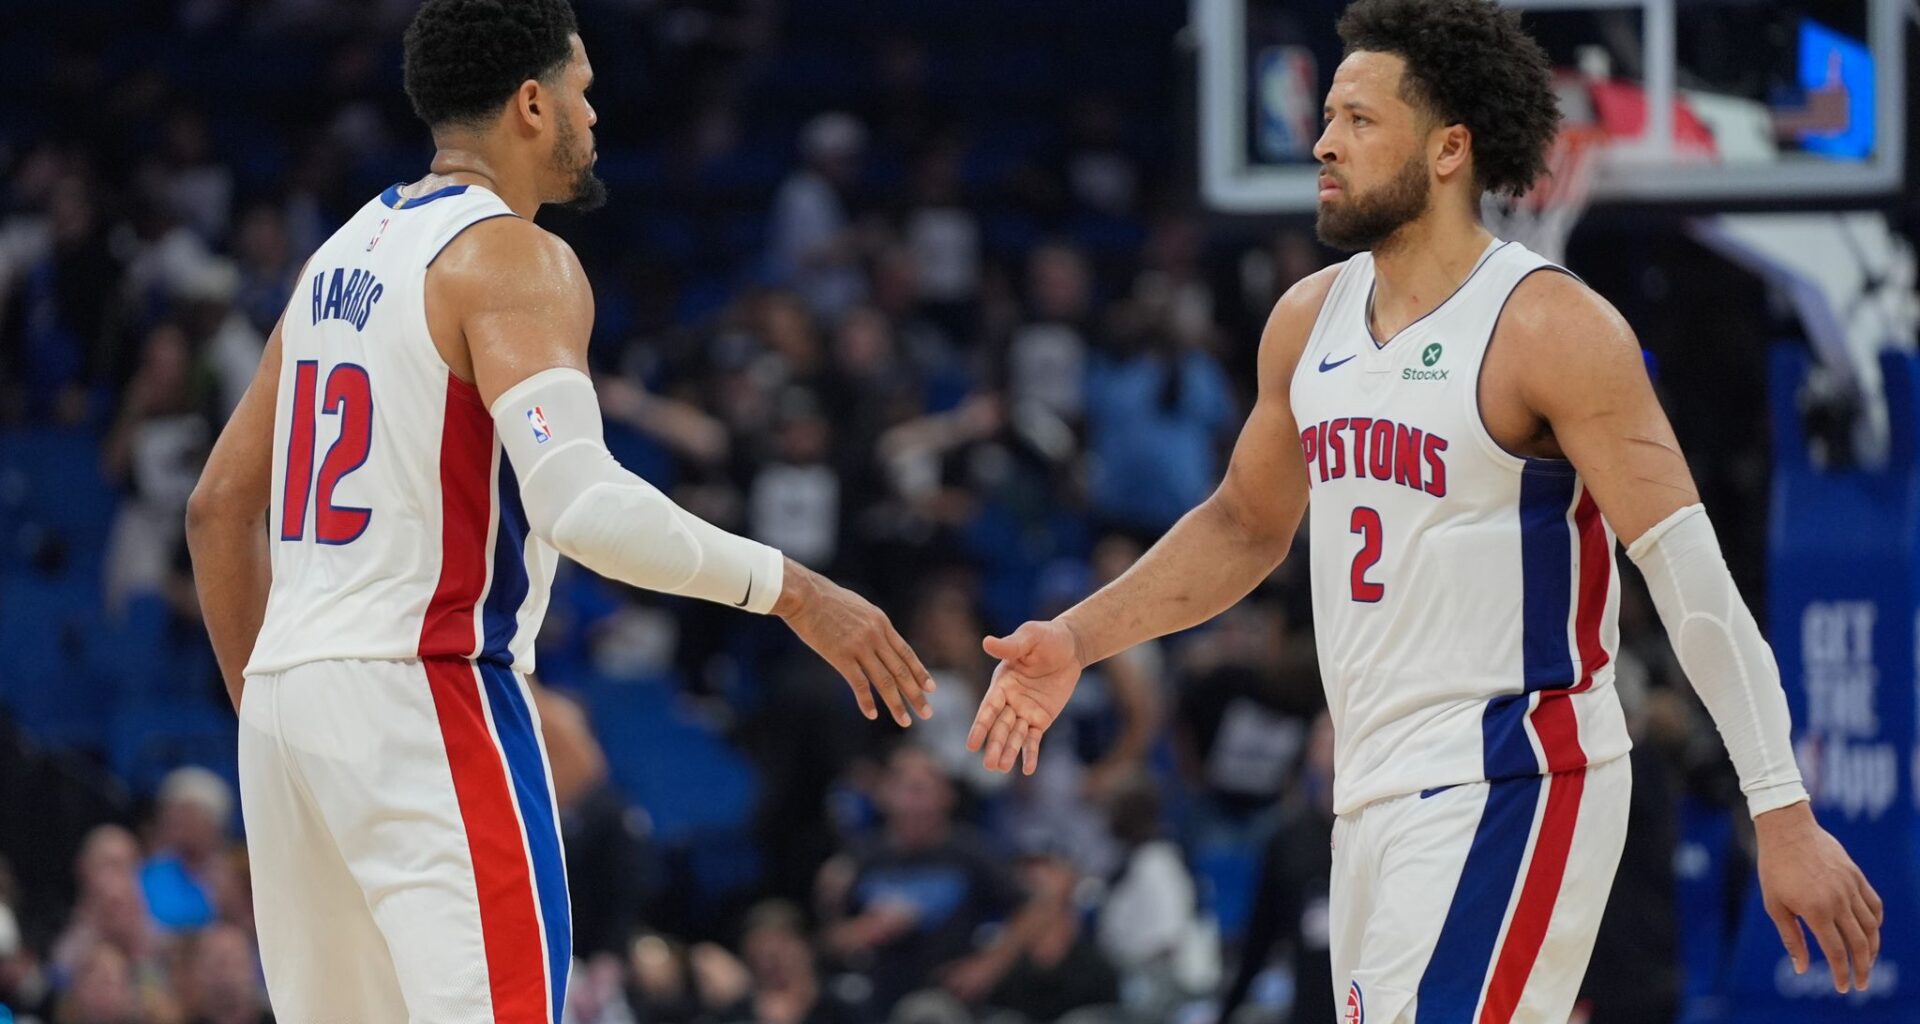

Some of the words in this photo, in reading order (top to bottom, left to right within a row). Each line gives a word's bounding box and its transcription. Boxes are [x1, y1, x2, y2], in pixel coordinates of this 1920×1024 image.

[312, 267, 384, 332] HARRIS
[1402, 368, 1449, 380] StockX
[281, 360, 374, 545] 12
[1300, 417, 1449, 498] PISTONS
[1350, 506, 1384, 603] 2
